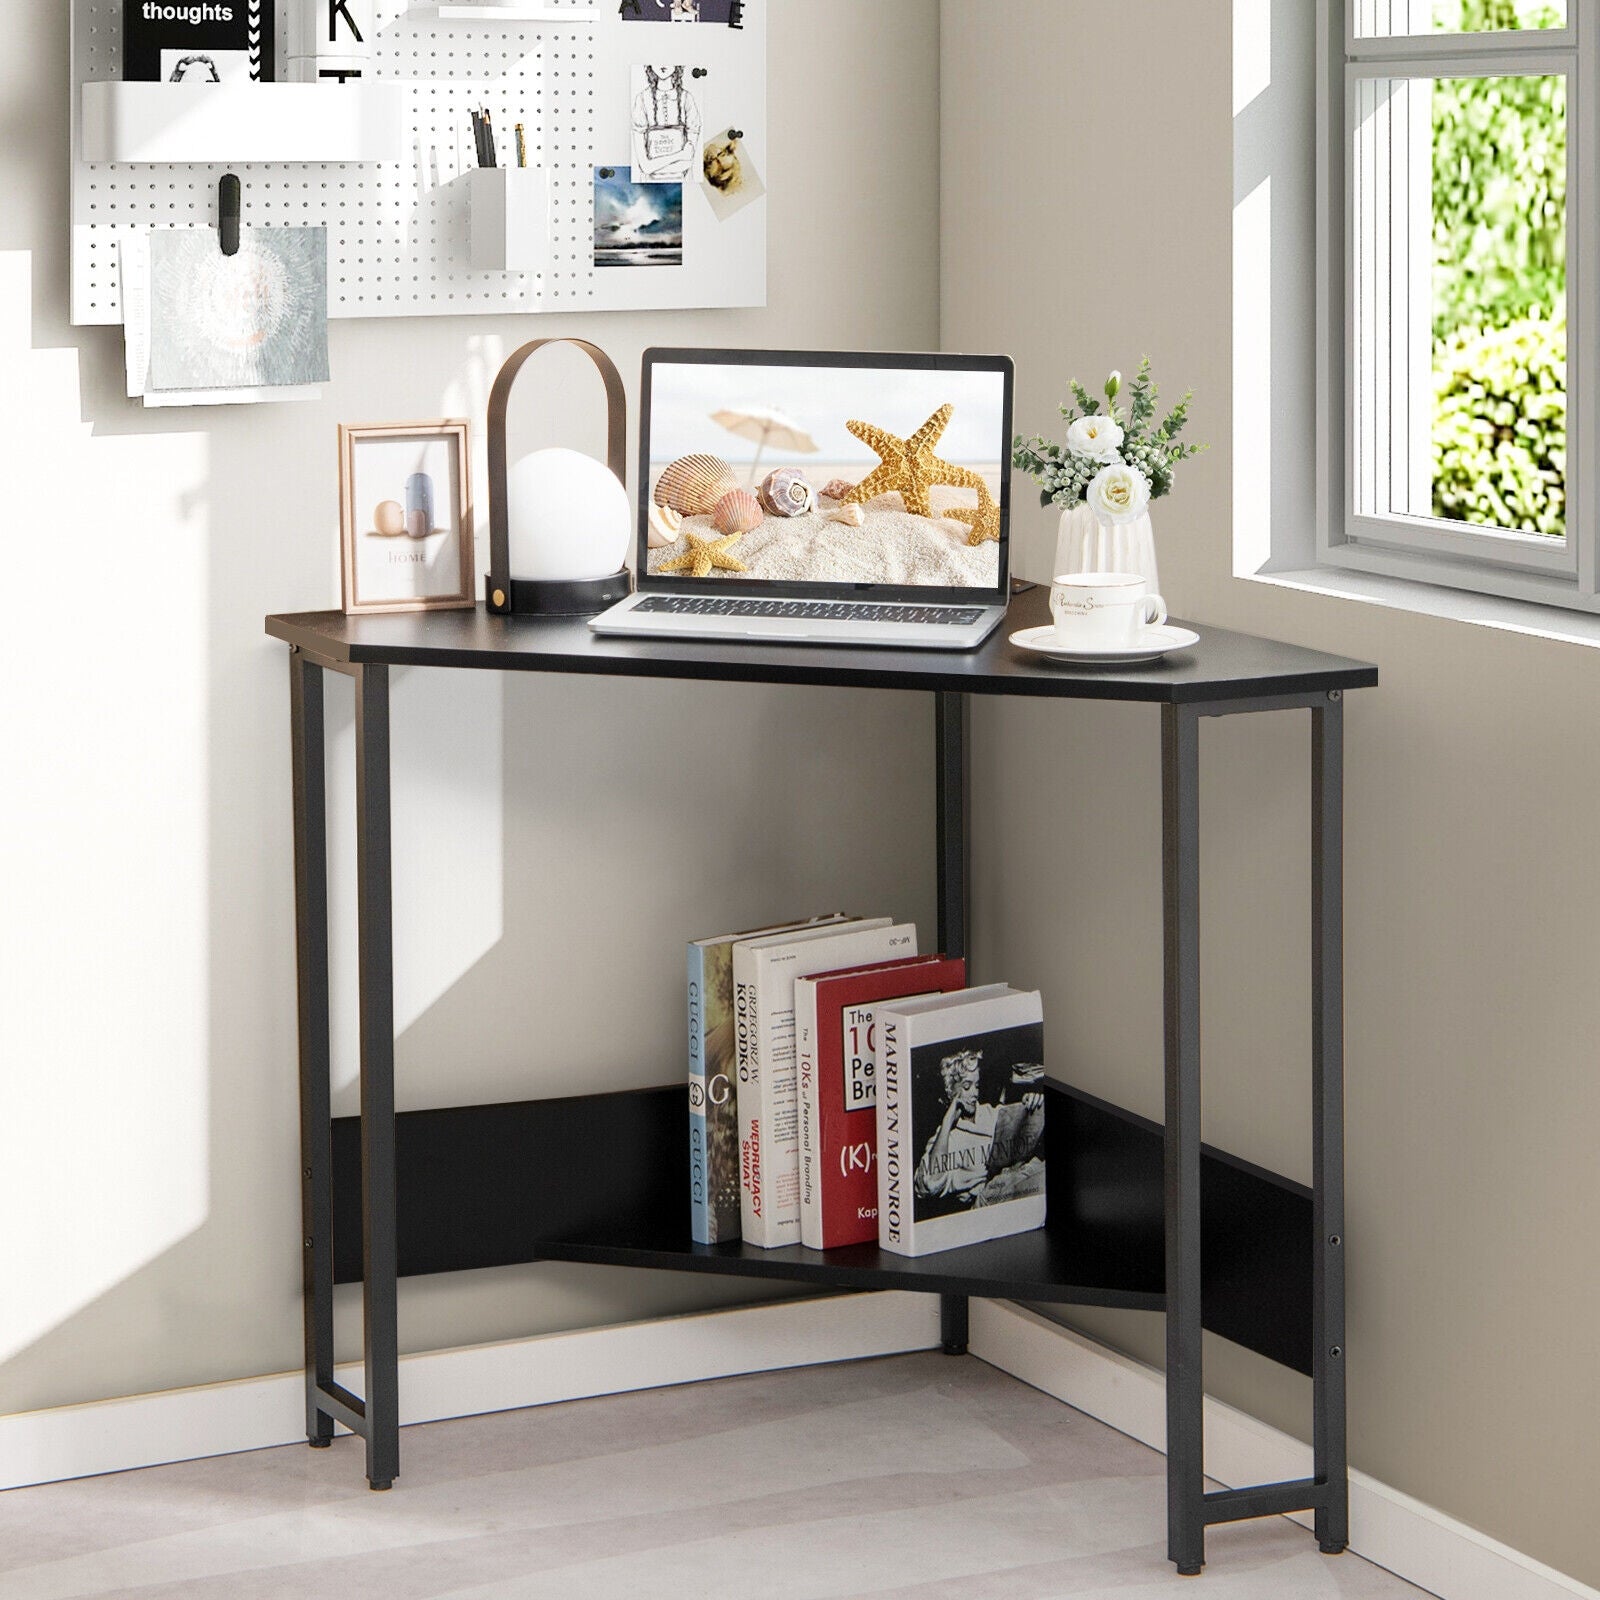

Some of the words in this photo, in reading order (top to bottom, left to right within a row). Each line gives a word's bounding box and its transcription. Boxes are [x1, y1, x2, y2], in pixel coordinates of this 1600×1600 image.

[142, 2, 234, 25] thoughts
[689, 981, 699, 1061] GUCCI
[748, 984, 758, 1066] GRZEGORZ
[849, 1009, 873, 1025] The
[885, 1022, 899, 1134] MARILYN
[801, 1101, 811, 1152] Personal
[692, 1128, 702, 1206] GUCCI
[801, 1155, 813, 1205] Branding
[888, 1138, 901, 1244] MONROE
[920, 1147, 976, 1177] MARILYN
